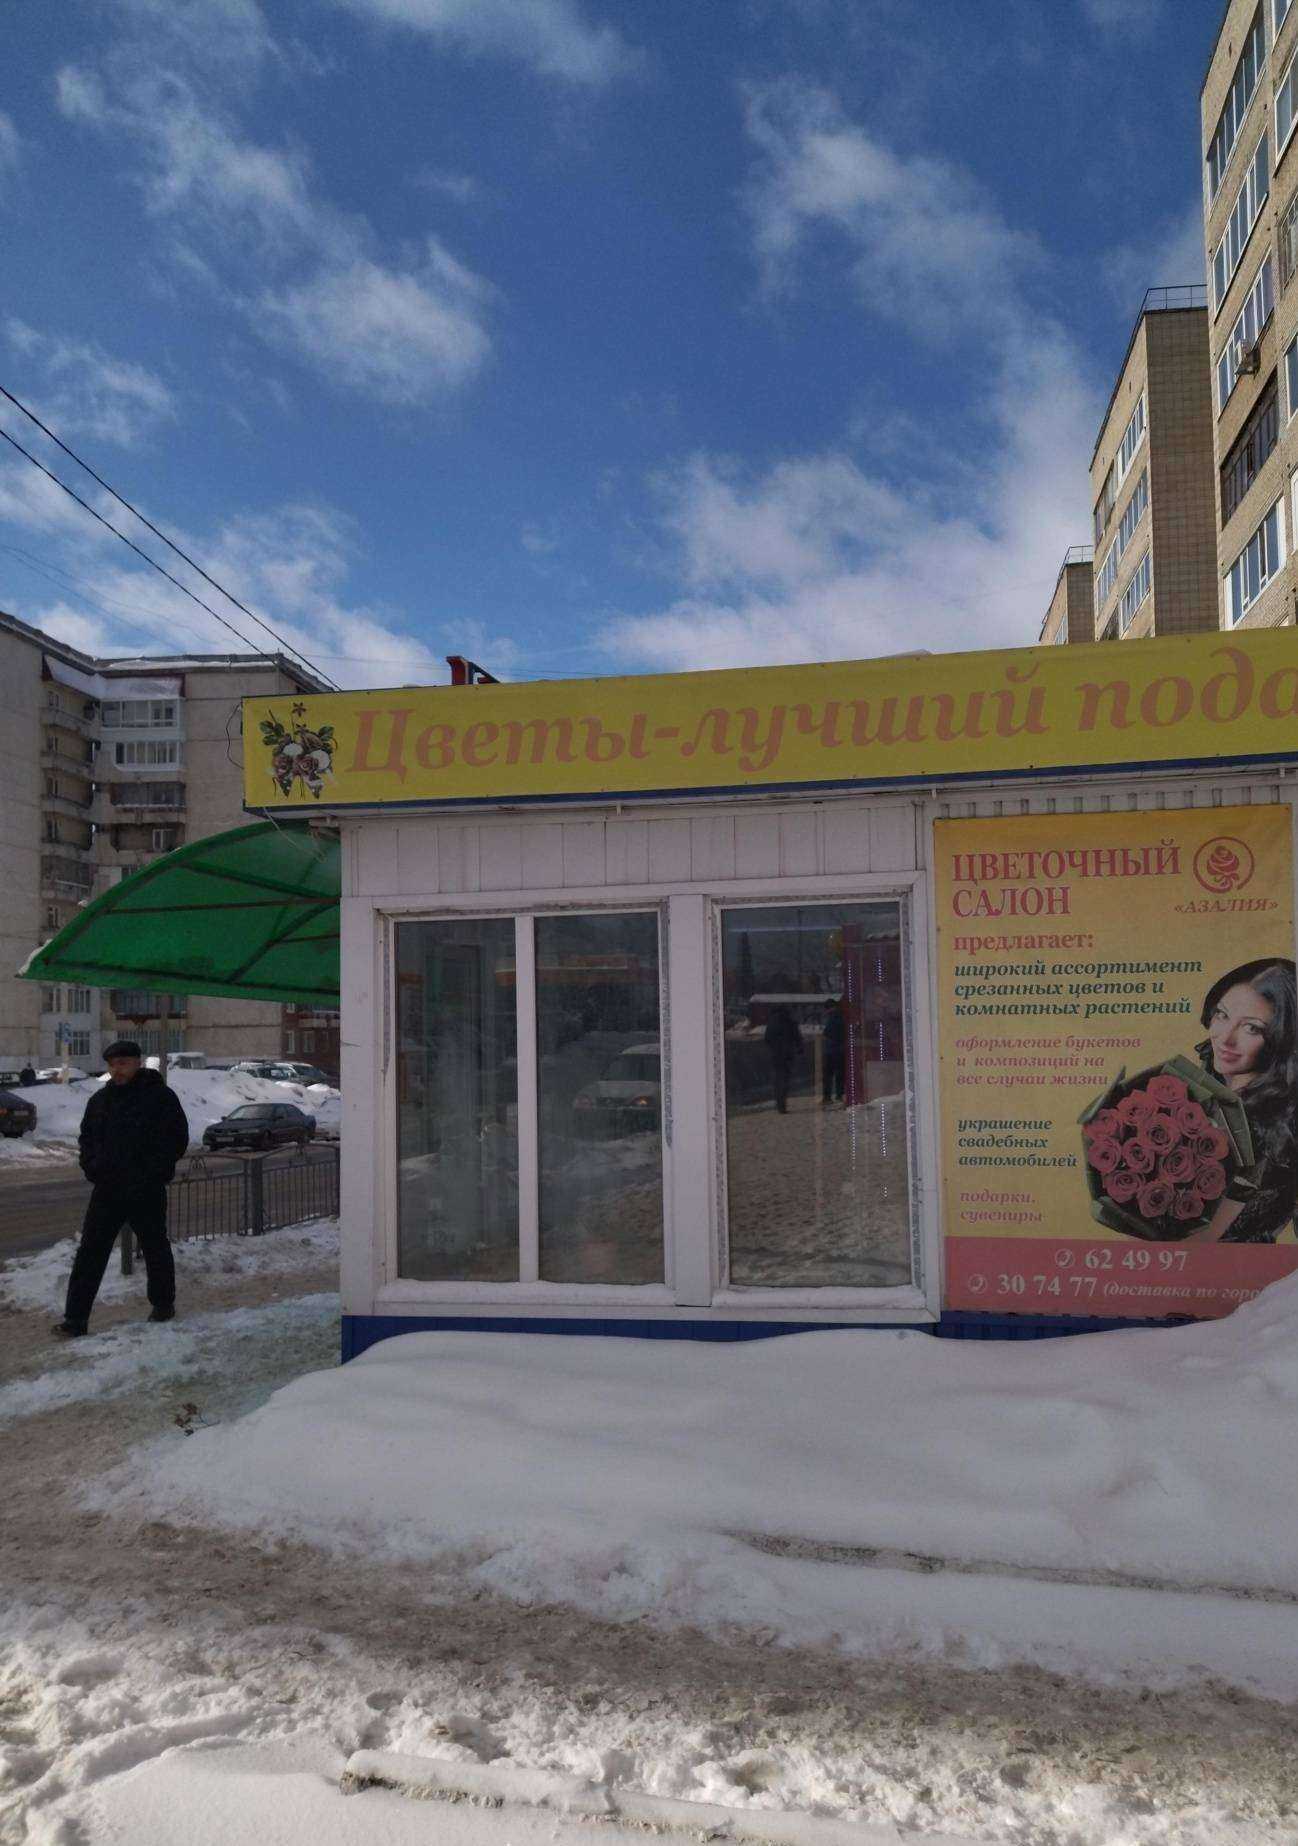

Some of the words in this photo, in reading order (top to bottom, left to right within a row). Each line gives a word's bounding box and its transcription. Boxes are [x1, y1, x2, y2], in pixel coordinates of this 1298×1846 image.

[347, 661, 1050, 783] Цветы-лучший
[952, 838, 1182, 886] ЦВЕТОЧНЫЙ
[952, 887, 1071, 917] САЛОН
[1174, 898, 1279, 913] «АЗАЛИЯ»
[953, 933, 1094, 955] предлагает:
[954, 960, 1046, 978] широкий
[1051, 960, 1203, 978] ассортимент
[954, 982, 1063, 999] срезанных
[1069, 980, 1146, 998] цветов
[1152, 981, 1164, 994] и
[955, 1002, 1081, 1016] комнатных
[1085, 998, 1191, 1019] растений
[955, 1036, 1062, 1051] оформление
[1065, 1035, 1142, 1052] букетов
[956, 1057, 967, 1068] и
[974, 1053, 1080, 1069] композиций
[1084, 1057, 1105, 1067] на
[956, 1074, 983, 1086] все
[986, 1074, 1046, 1087] случаи
[1051, 1074, 1108, 1086] жизни
[958, 1120, 1053, 1132] украшение
[958, 1134, 1048, 1148] свадебных
[958, 1153, 1077, 1168] автомобилей
[1085, 1250, 1113, 1269] 62
[1122, 1250, 1150, 1270] 49
[1159, 1251, 1189, 1271] 97
[997, 1275, 1025, 1295] 30
[1033, 1276, 1061, 1296] 74
[1069, 1277, 1098, 1297] 77
[1103, 1281, 1191, 1297] (доставка
[1196, 1288, 1217, 1297] по
